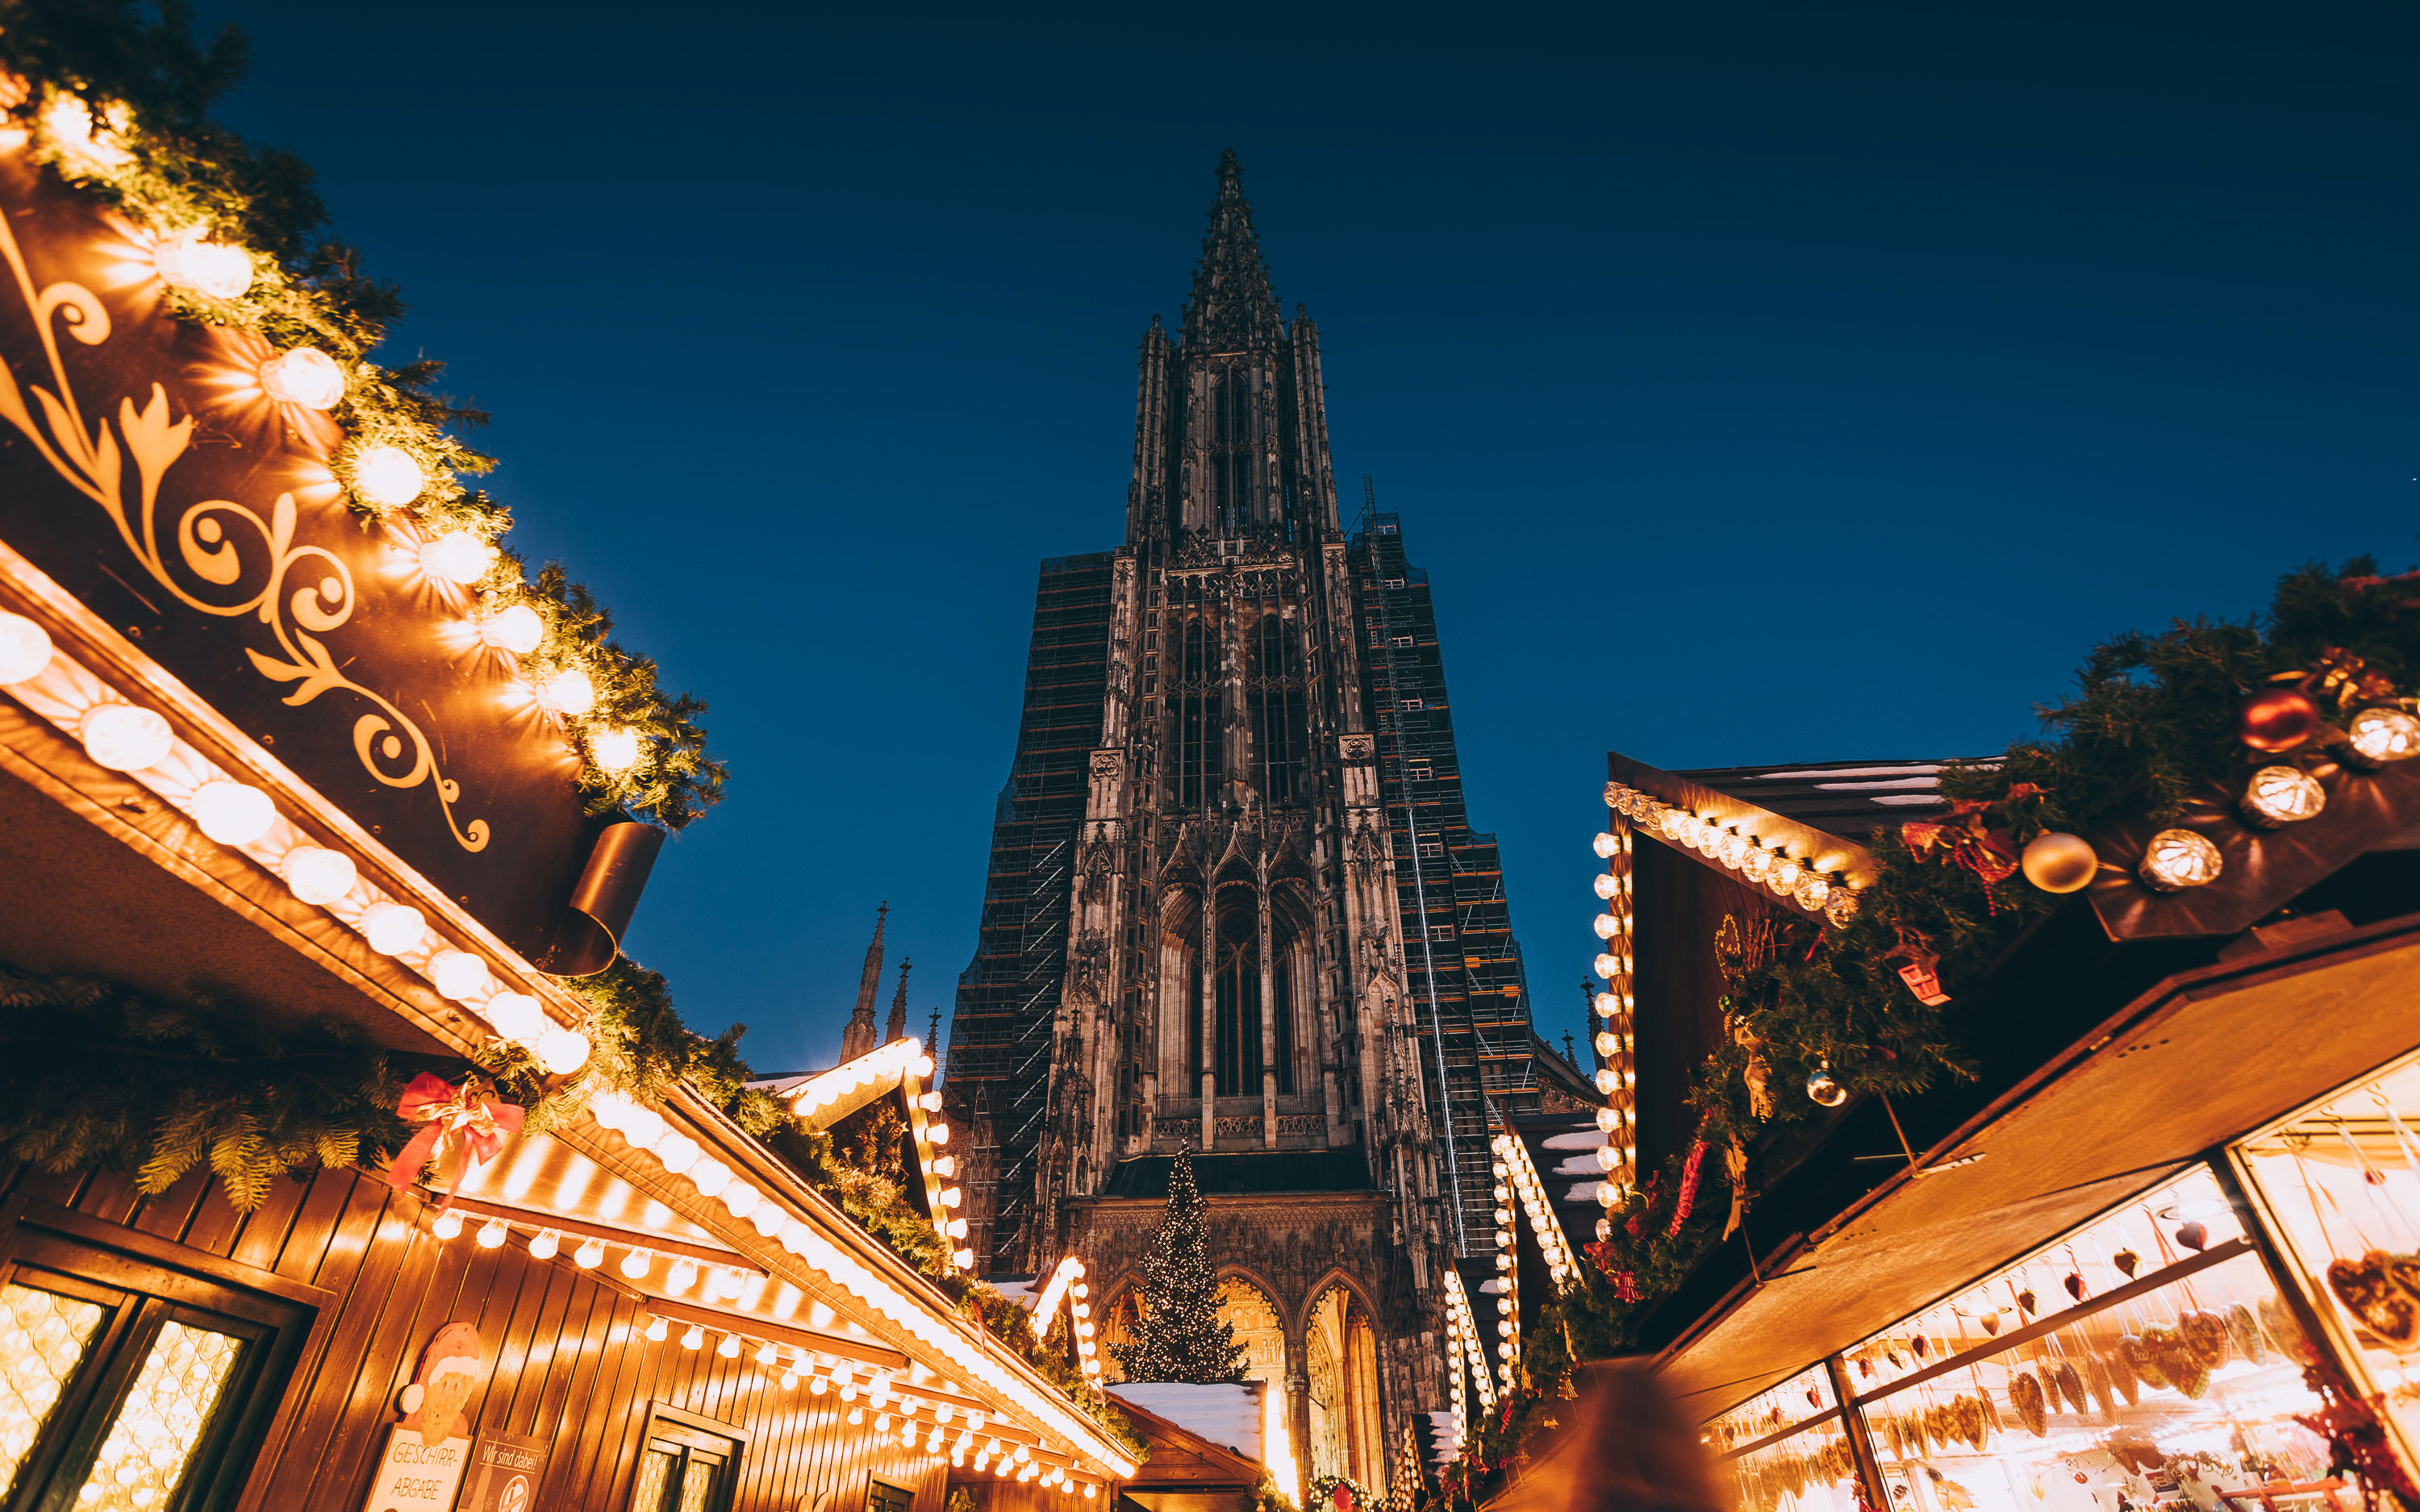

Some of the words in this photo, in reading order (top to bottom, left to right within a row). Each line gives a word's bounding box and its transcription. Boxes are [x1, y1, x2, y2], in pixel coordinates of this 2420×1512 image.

[393, 1442, 458, 1468] GESCHIRR-
[482, 1444, 498, 1463] Wir
[497, 1448, 516, 1466] sind
[514, 1451, 538, 1471] dabei!
[390, 1477, 443, 1500] ABGABE
